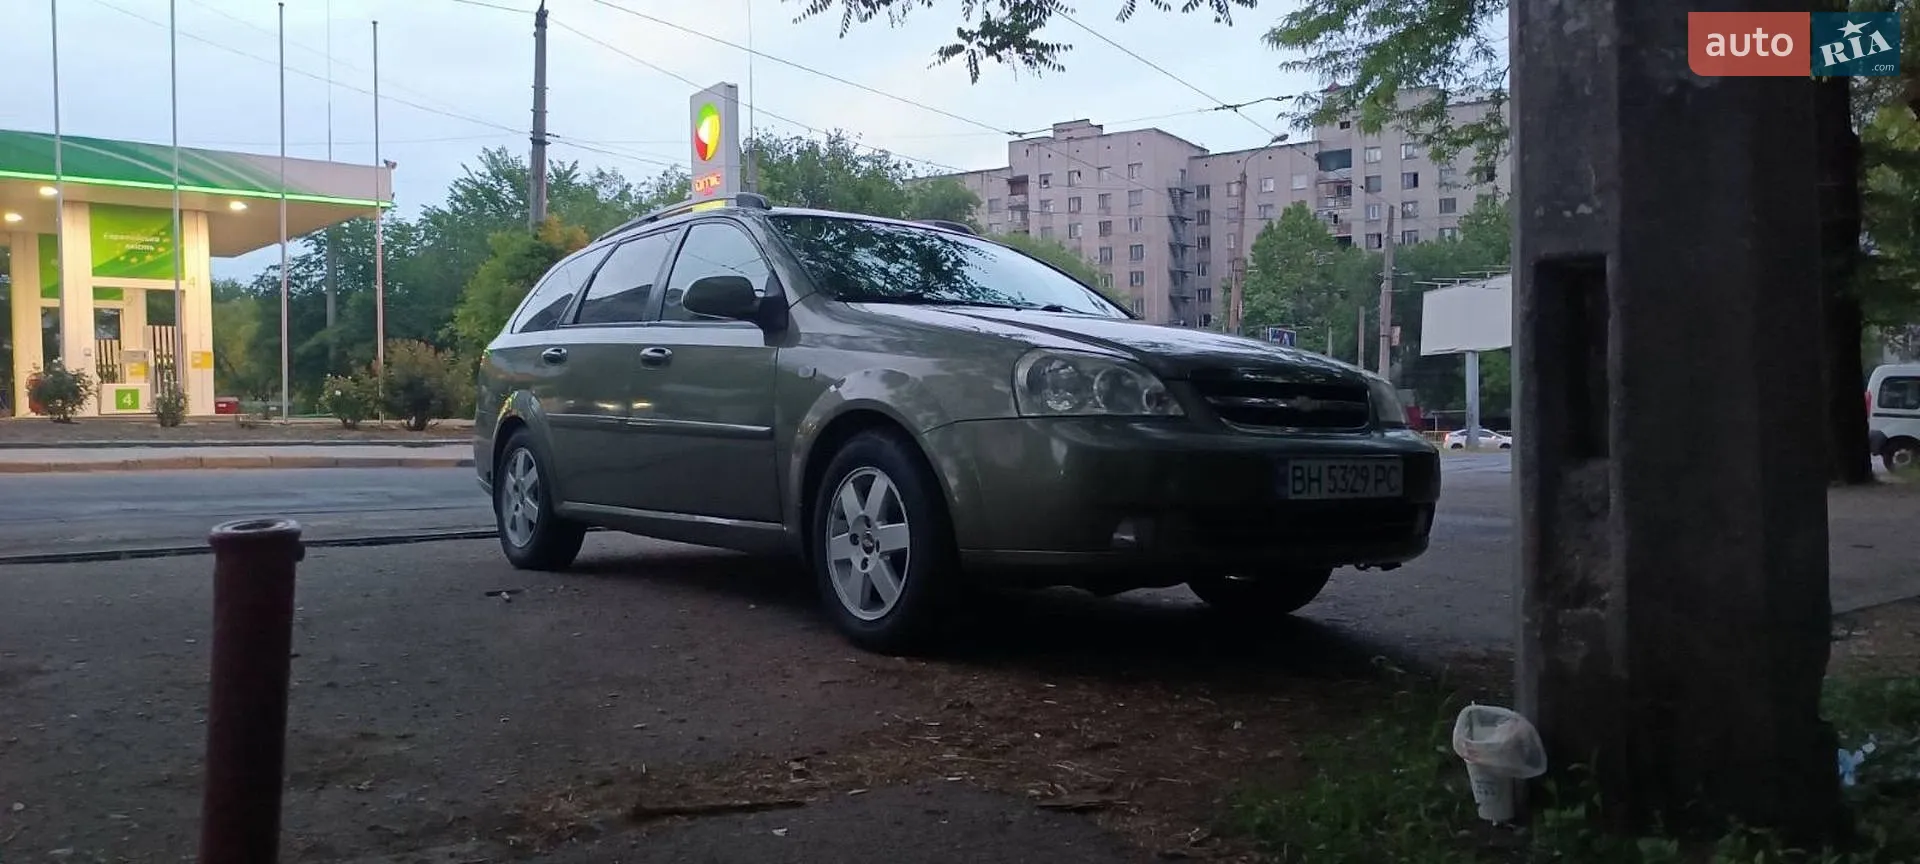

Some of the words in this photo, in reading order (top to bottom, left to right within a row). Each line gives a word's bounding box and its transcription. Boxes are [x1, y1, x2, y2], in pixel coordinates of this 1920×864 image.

[122, 393, 134, 407] 4
[1291, 464, 1322, 495] BH
[1327, 464, 1370, 494] 5329
[1374, 464, 1399, 493] PC
